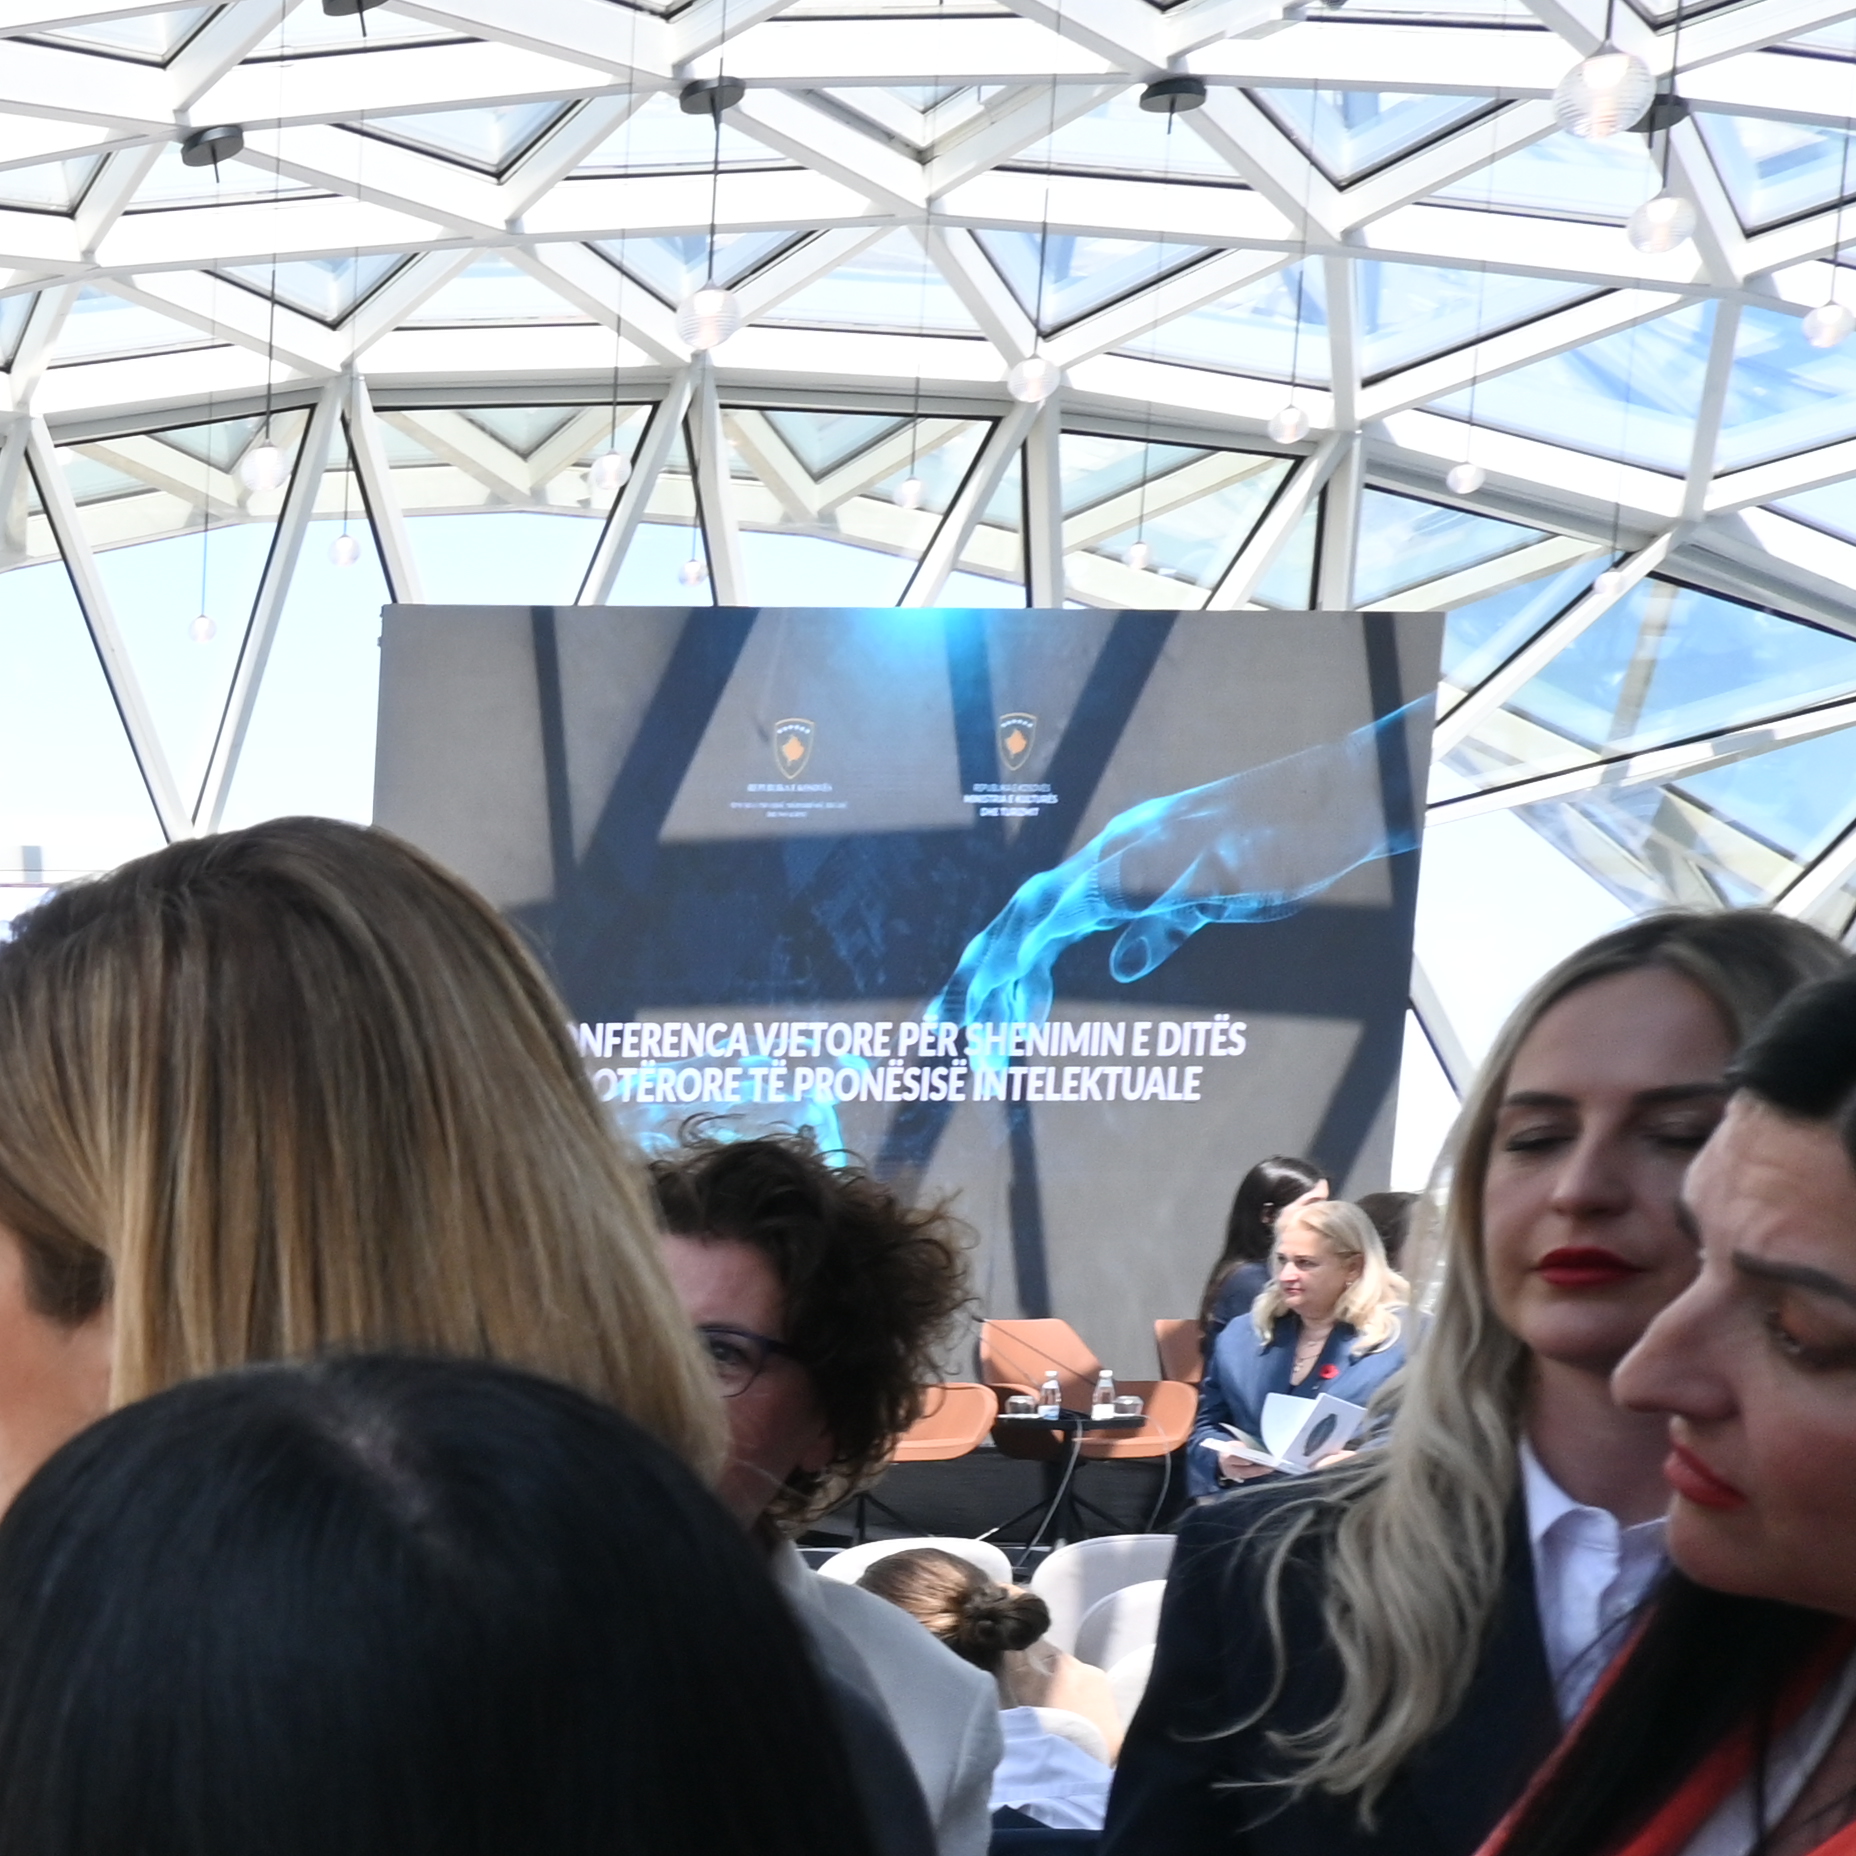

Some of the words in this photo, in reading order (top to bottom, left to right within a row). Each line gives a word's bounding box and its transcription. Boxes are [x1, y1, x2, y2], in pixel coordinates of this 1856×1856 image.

[753, 1022, 893, 1059] VJETORE
[898, 1013, 959, 1057] PËR
[964, 1021, 1126, 1057] SHENIMIN
[1132, 1021, 1152, 1057] E
[1157, 1013, 1248, 1057] DITËS
[592, 1059, 742, 1102] OTËRORE
[748, 1059, 788, 1102] TË
[793, 1059, 968, 1102] PRONËSISË
[972, 1065, 1204, 1101] INTELEKTUALE
